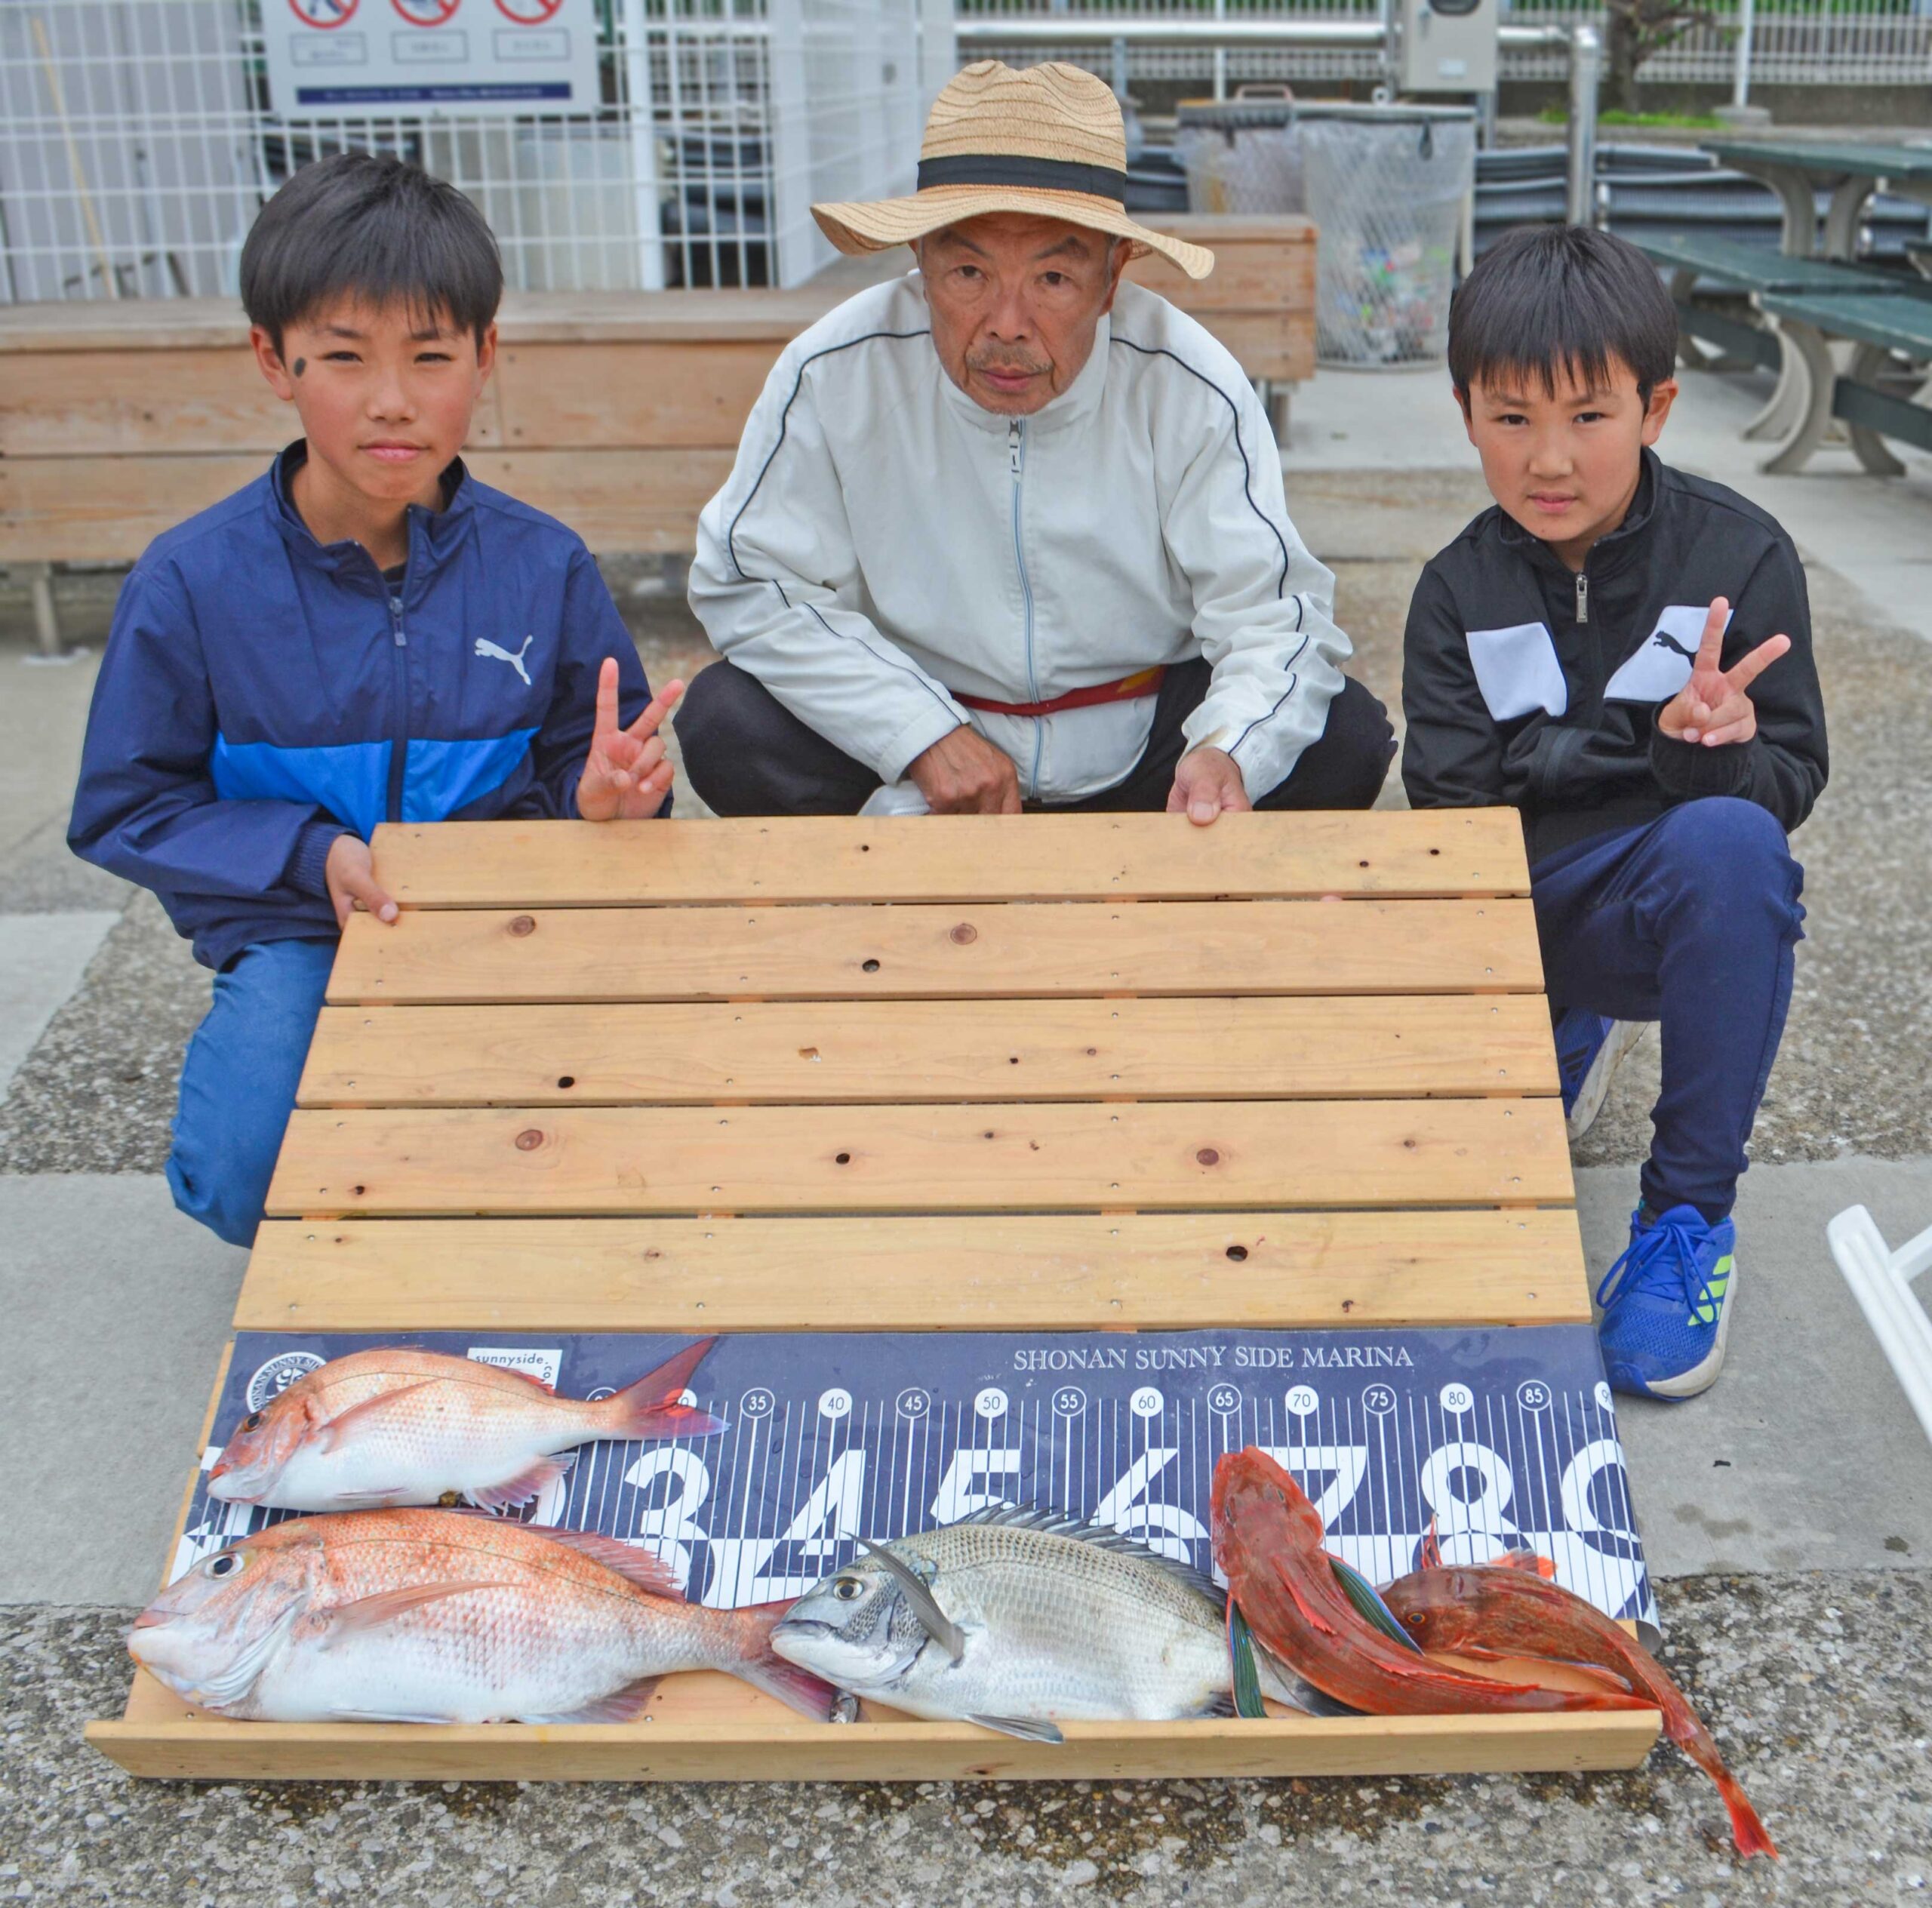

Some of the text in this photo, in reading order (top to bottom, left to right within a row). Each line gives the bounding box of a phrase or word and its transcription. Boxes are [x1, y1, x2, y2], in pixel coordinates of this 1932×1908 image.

[1014, 1346, 1414, 1371] SHONAN SUNNY SIDE MARINA
[252, 1375, 266, 1409] HONAN
[266, 1356, 303, 1377] SUNNY
[748, 1396, 767, 1411] 35
[827, 1396, 845, 1410] 40
[904, 1396, 923, 1411] 45
[983, 1396, 1001, 1410] 50
[1060, 1394, 1078, 1409] 55
[1138, 1396, 1156, 1409] 60
[1215, 1392, 1234, 1408] 65
[1293, 1393, 1311, 1408] 70
[1370, 1392, 1389, 1408] 75
[1448, 1391, 1466, 1405] 80
[1524, 1388, 1543, 1403] 85
[624, 1448, 715, 1603] 3
[755, 1449, 866, 1577] 4
[1412, 1442, 1534, 1571] 8
